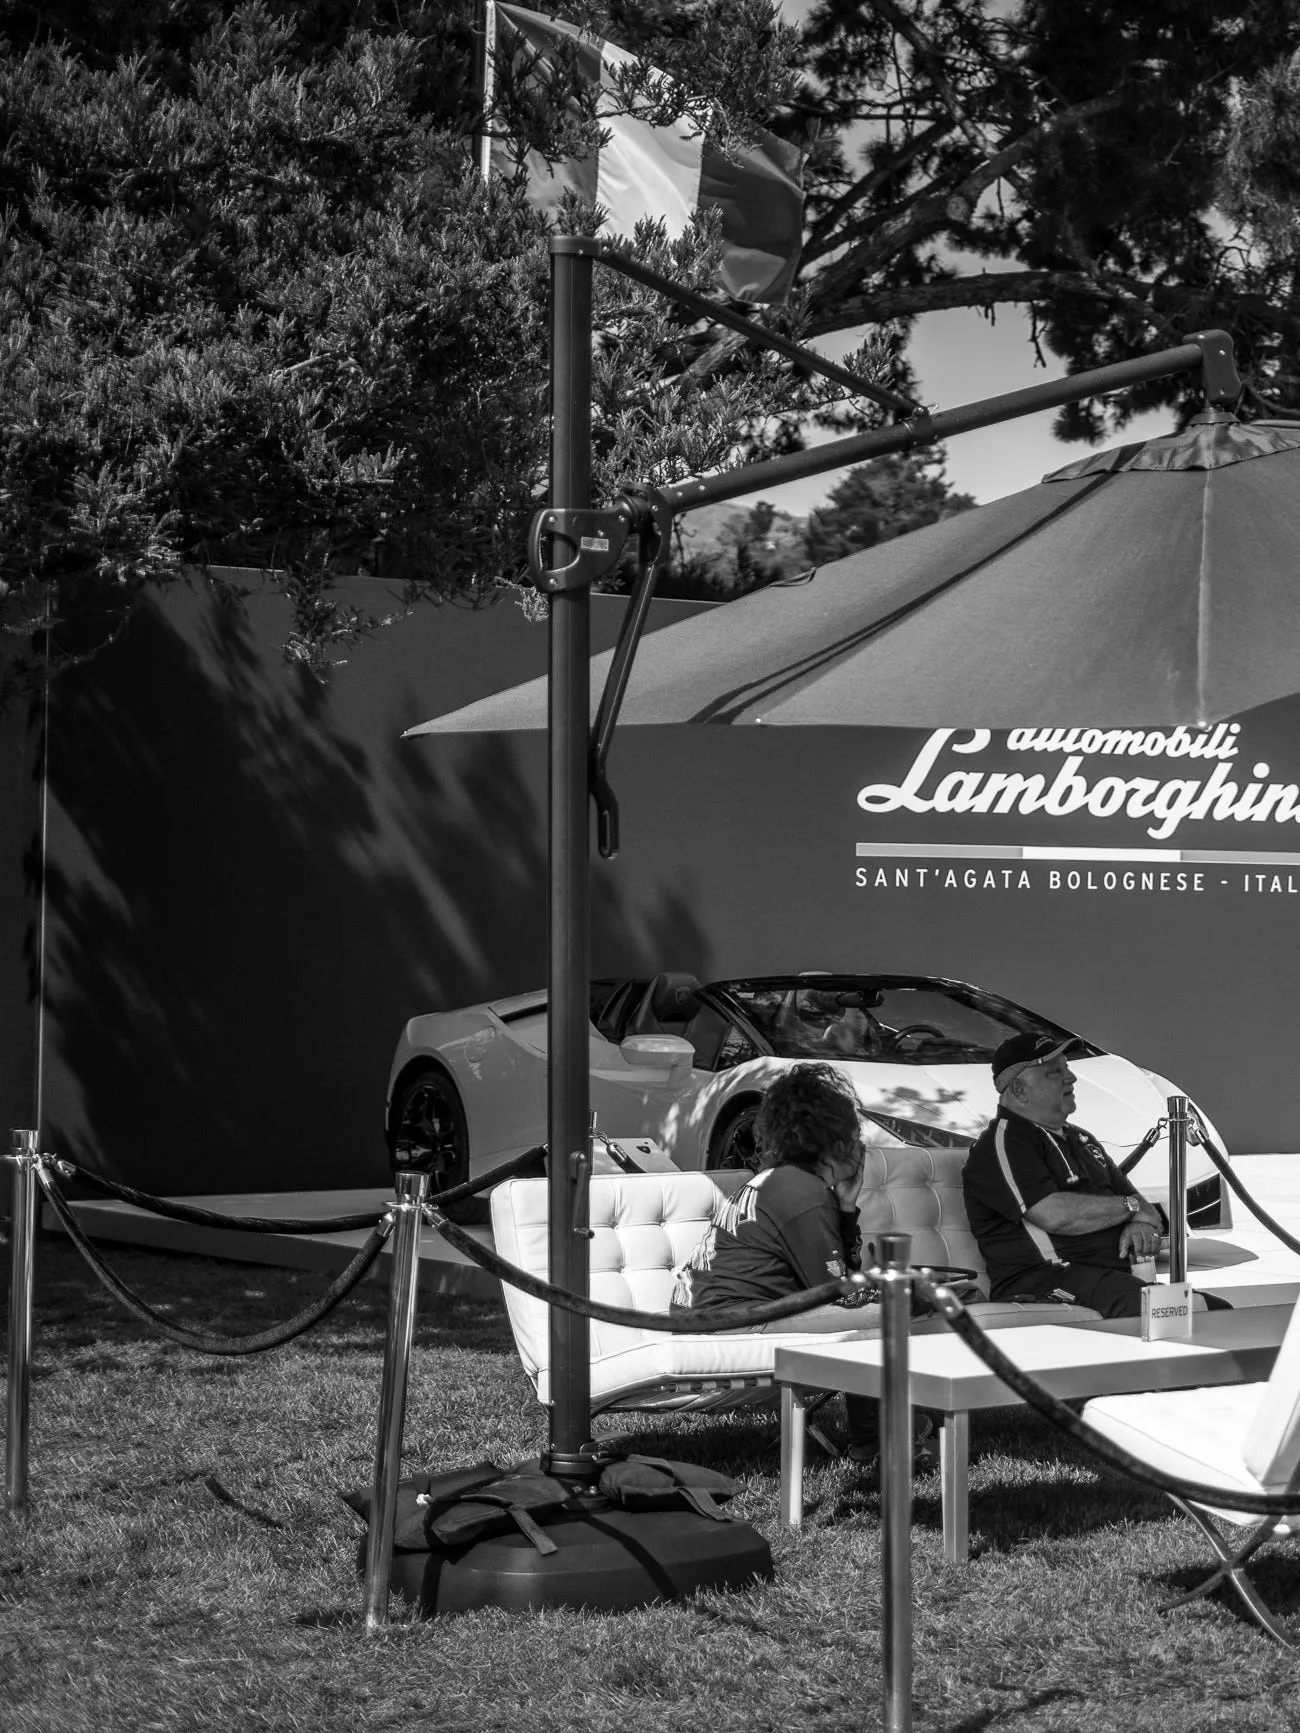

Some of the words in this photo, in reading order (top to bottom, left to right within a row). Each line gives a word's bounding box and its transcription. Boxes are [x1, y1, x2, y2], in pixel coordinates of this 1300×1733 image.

[1006, 722, 1241, 760] automobili
[855, 867, 1031, 889] SANT'AGATA
[1049, 870, 1205, 892] BOLOGNESE
[1151, 1305, 1189, 1319] RESERVED
